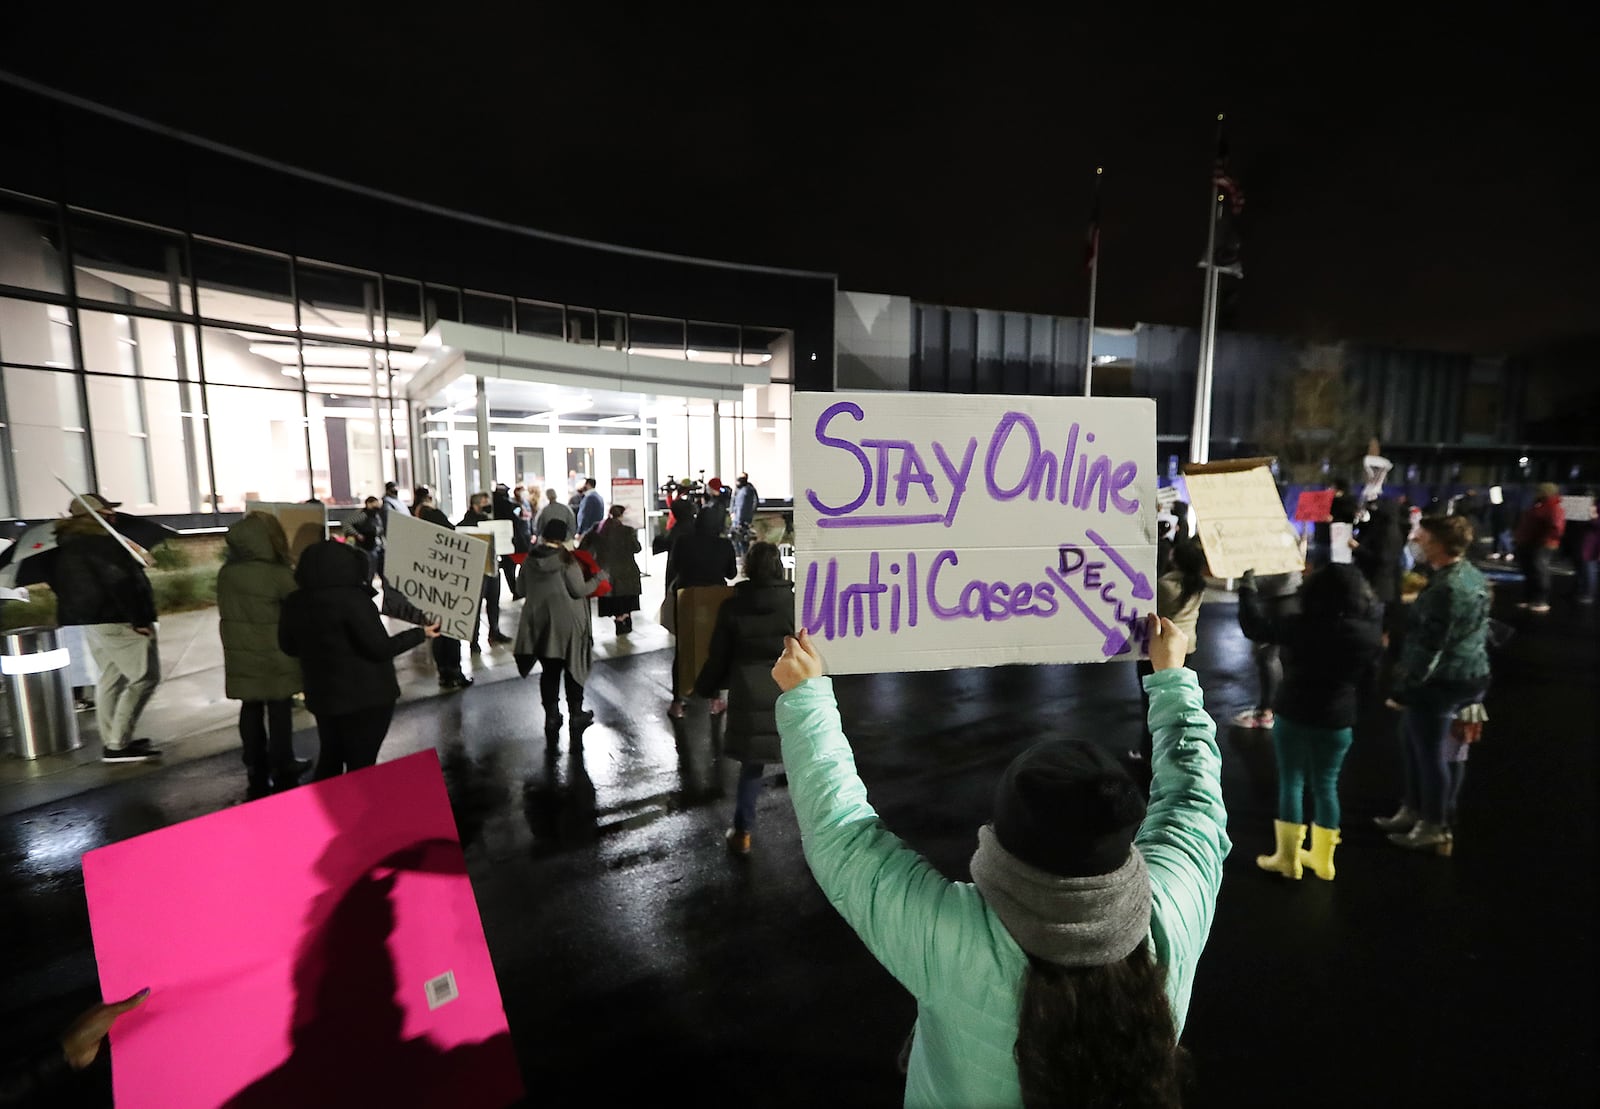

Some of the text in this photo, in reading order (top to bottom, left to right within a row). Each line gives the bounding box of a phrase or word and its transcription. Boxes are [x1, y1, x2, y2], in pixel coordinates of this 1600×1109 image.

[985, 411, 1140, 515] Online
[428, 547, 467, 570] LIKE
[435, 533, 471, 555] THIS
[413, 561, 470, 592] LEARN
[395, 575, 475, 616] CANNOT
[802, 550, 1060, 640] Until Cases
